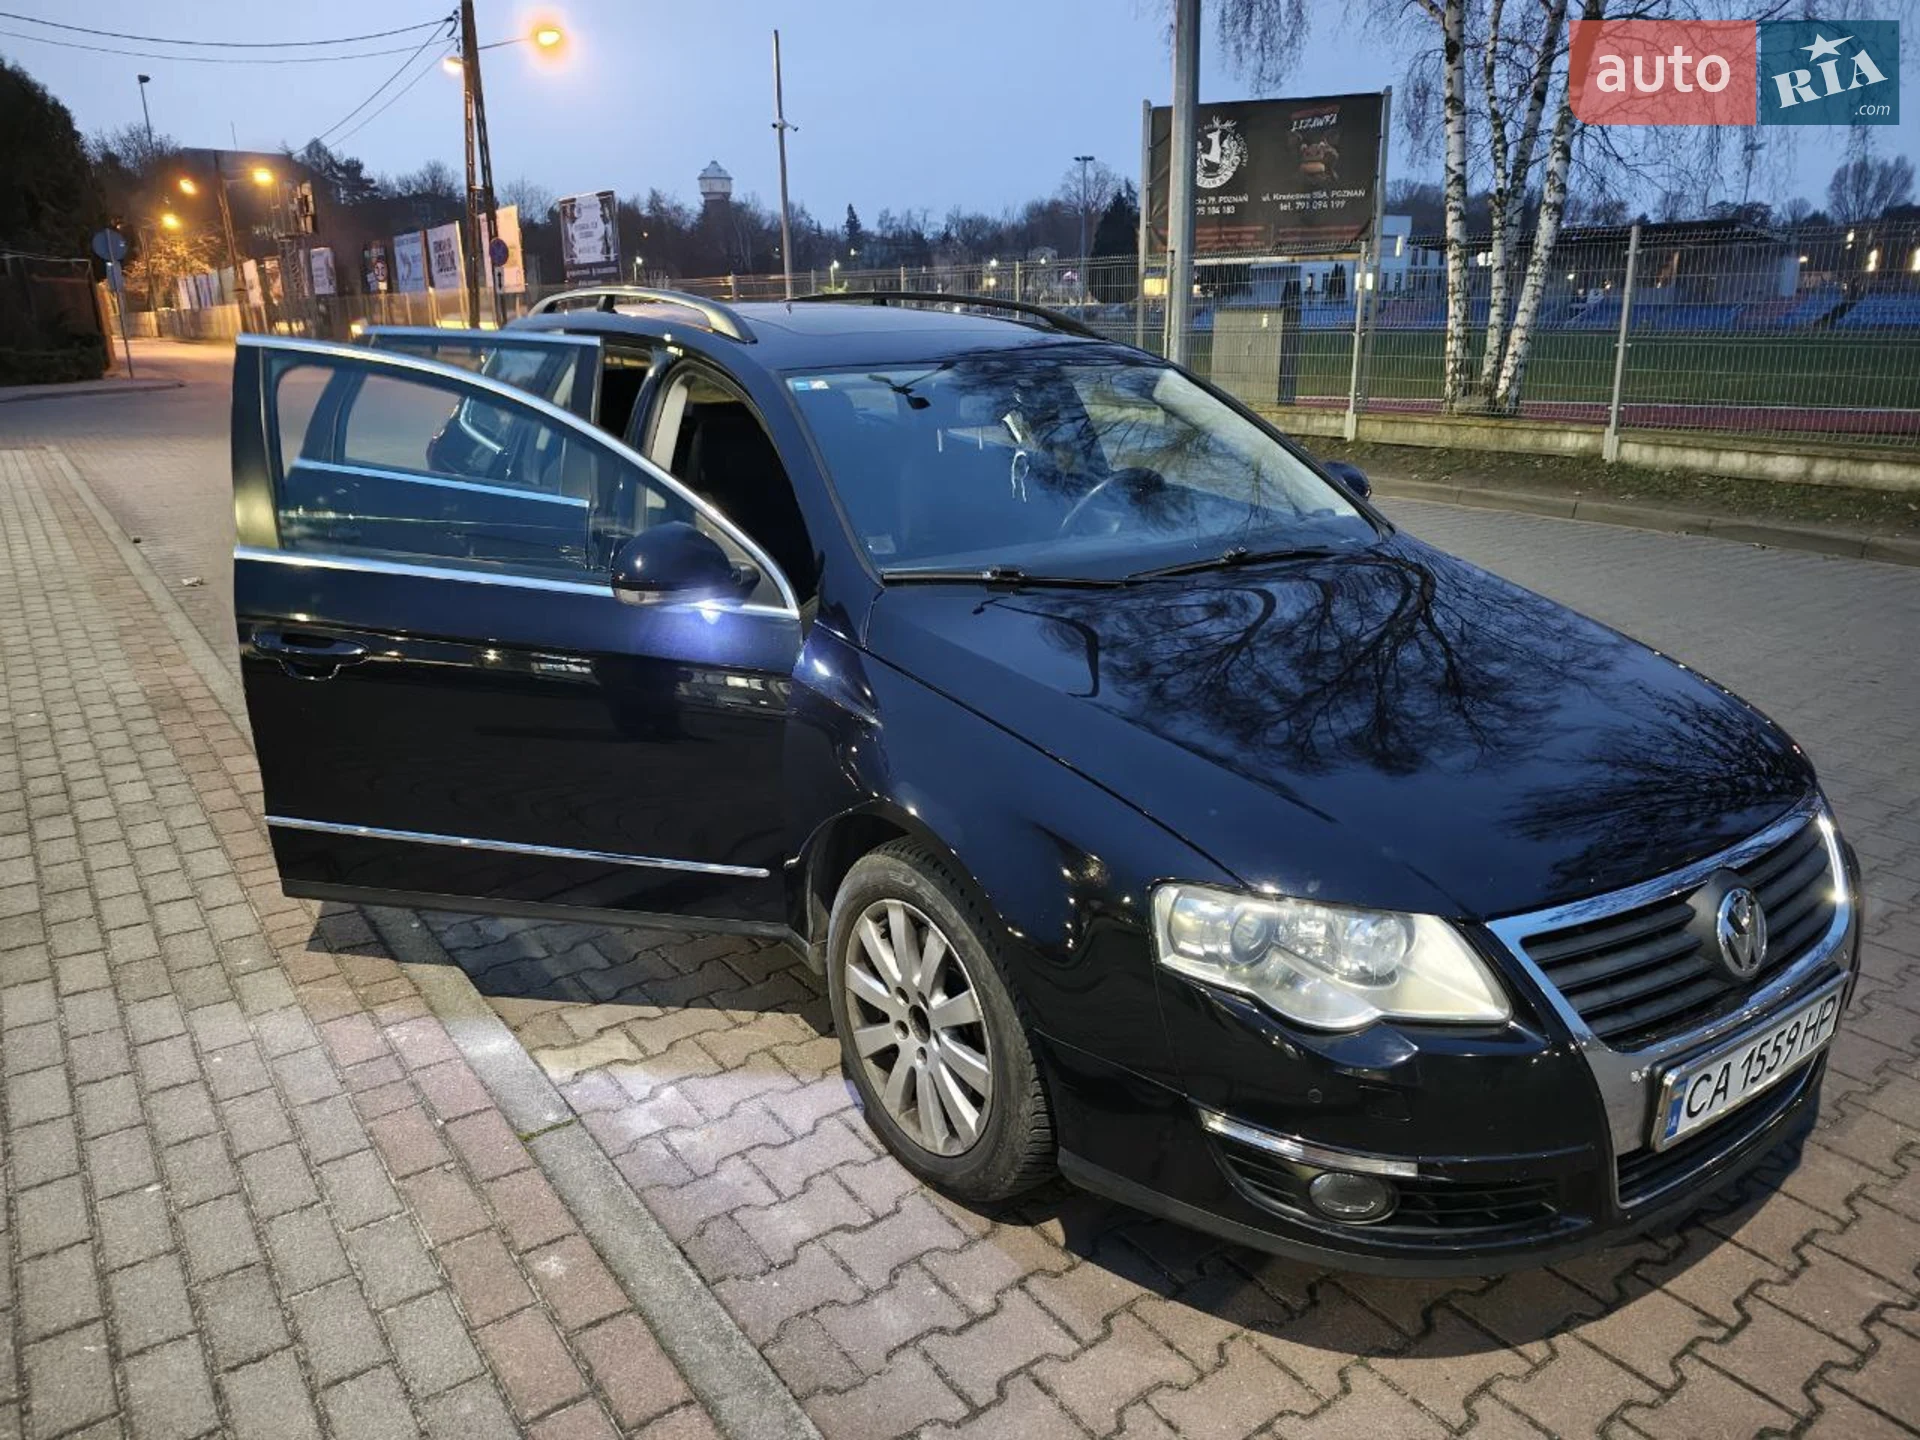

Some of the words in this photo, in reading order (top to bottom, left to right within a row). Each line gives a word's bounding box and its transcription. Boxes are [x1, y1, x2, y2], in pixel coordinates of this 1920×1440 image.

[1686, 1061, 1732, 1118] CA
[1740, 1020, 1801, 1092] 1559
[1798, 995, 1837, 1053] HP
